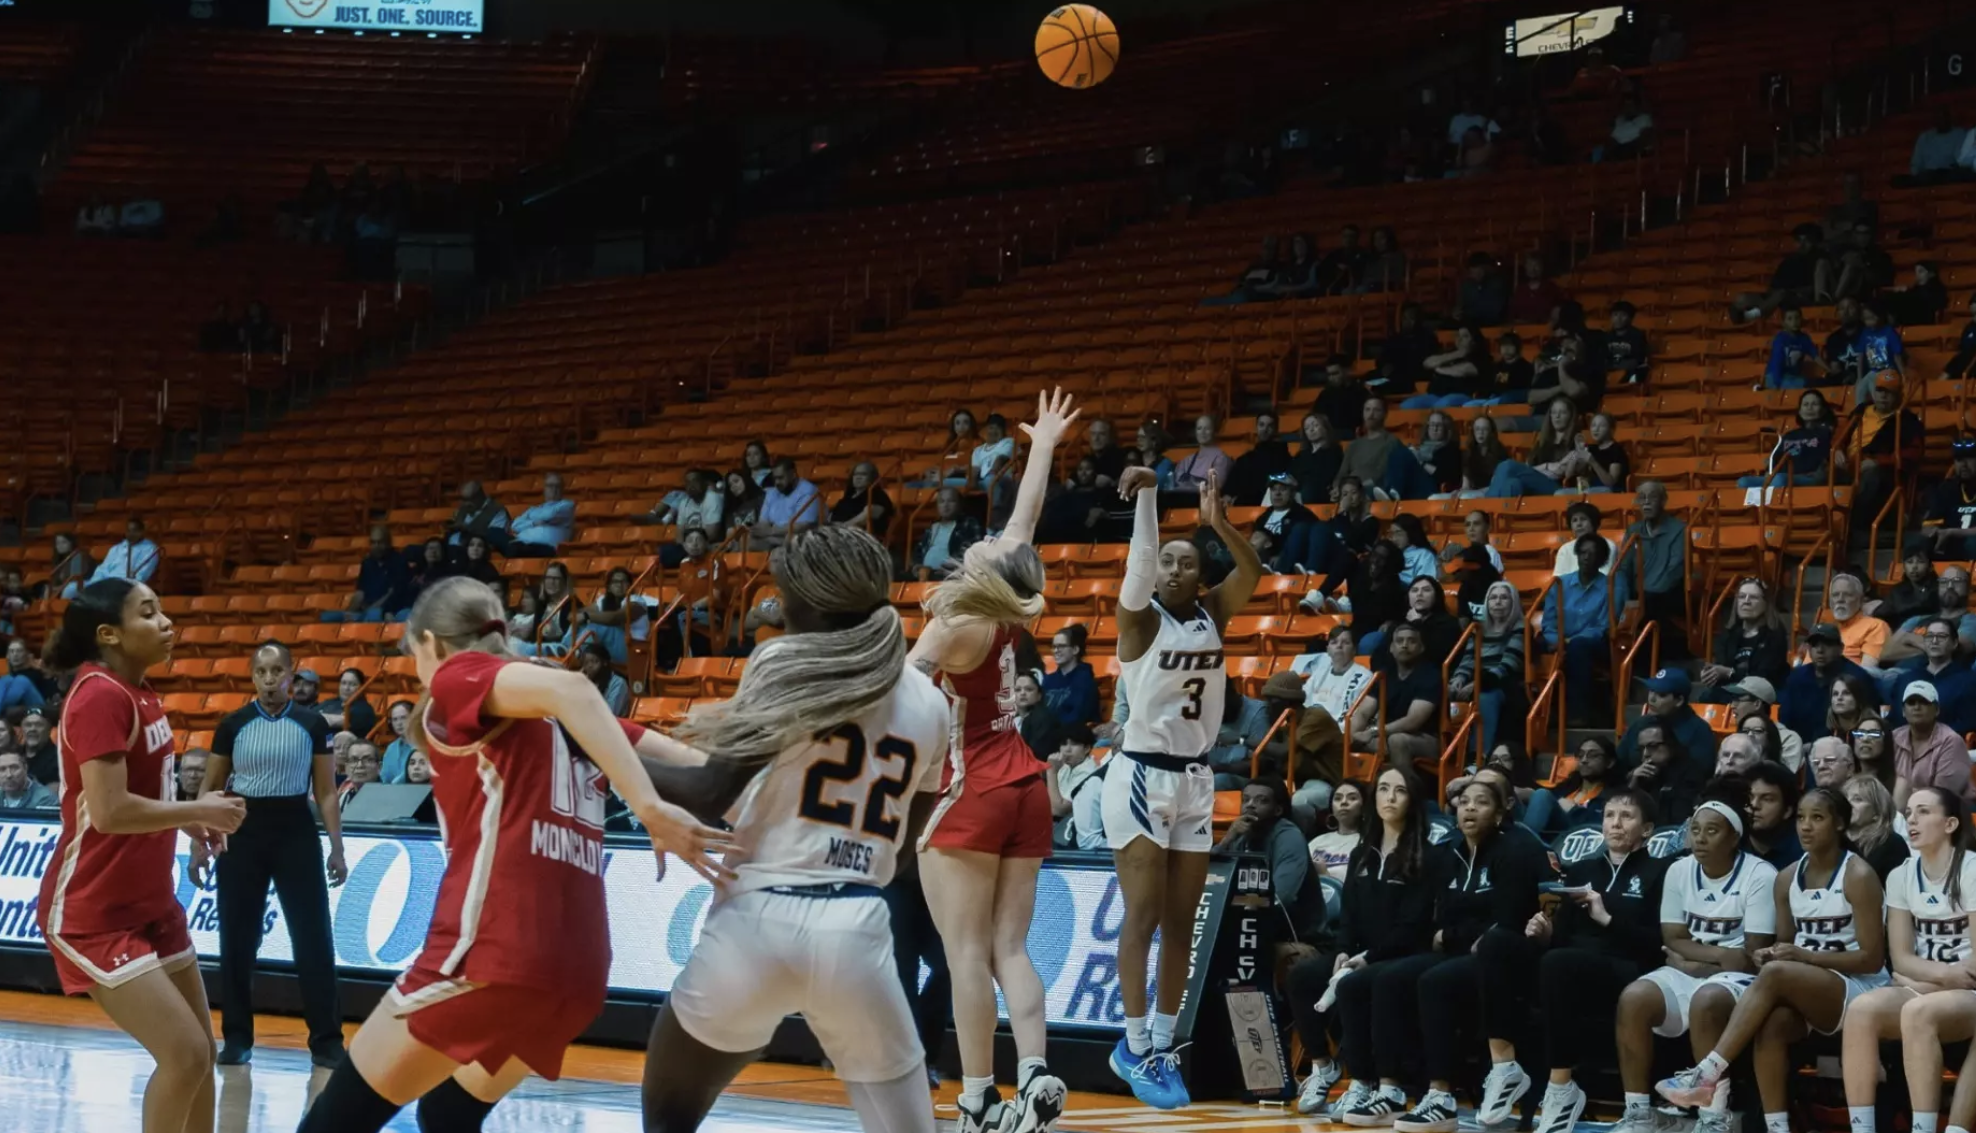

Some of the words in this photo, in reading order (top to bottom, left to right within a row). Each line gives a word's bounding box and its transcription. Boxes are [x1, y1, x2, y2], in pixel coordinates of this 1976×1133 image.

[335, 7, 372, 24] JUST.
[378, 7, 410, 25] ONE.
[415, 9, 478, 28] SOURCE.
[1948, 54, 1962, 75] G
[1181, 677, 1206, 720] 3
[797, 721, 917, 843] 22
[824, 836, 874, 875] MOSES
